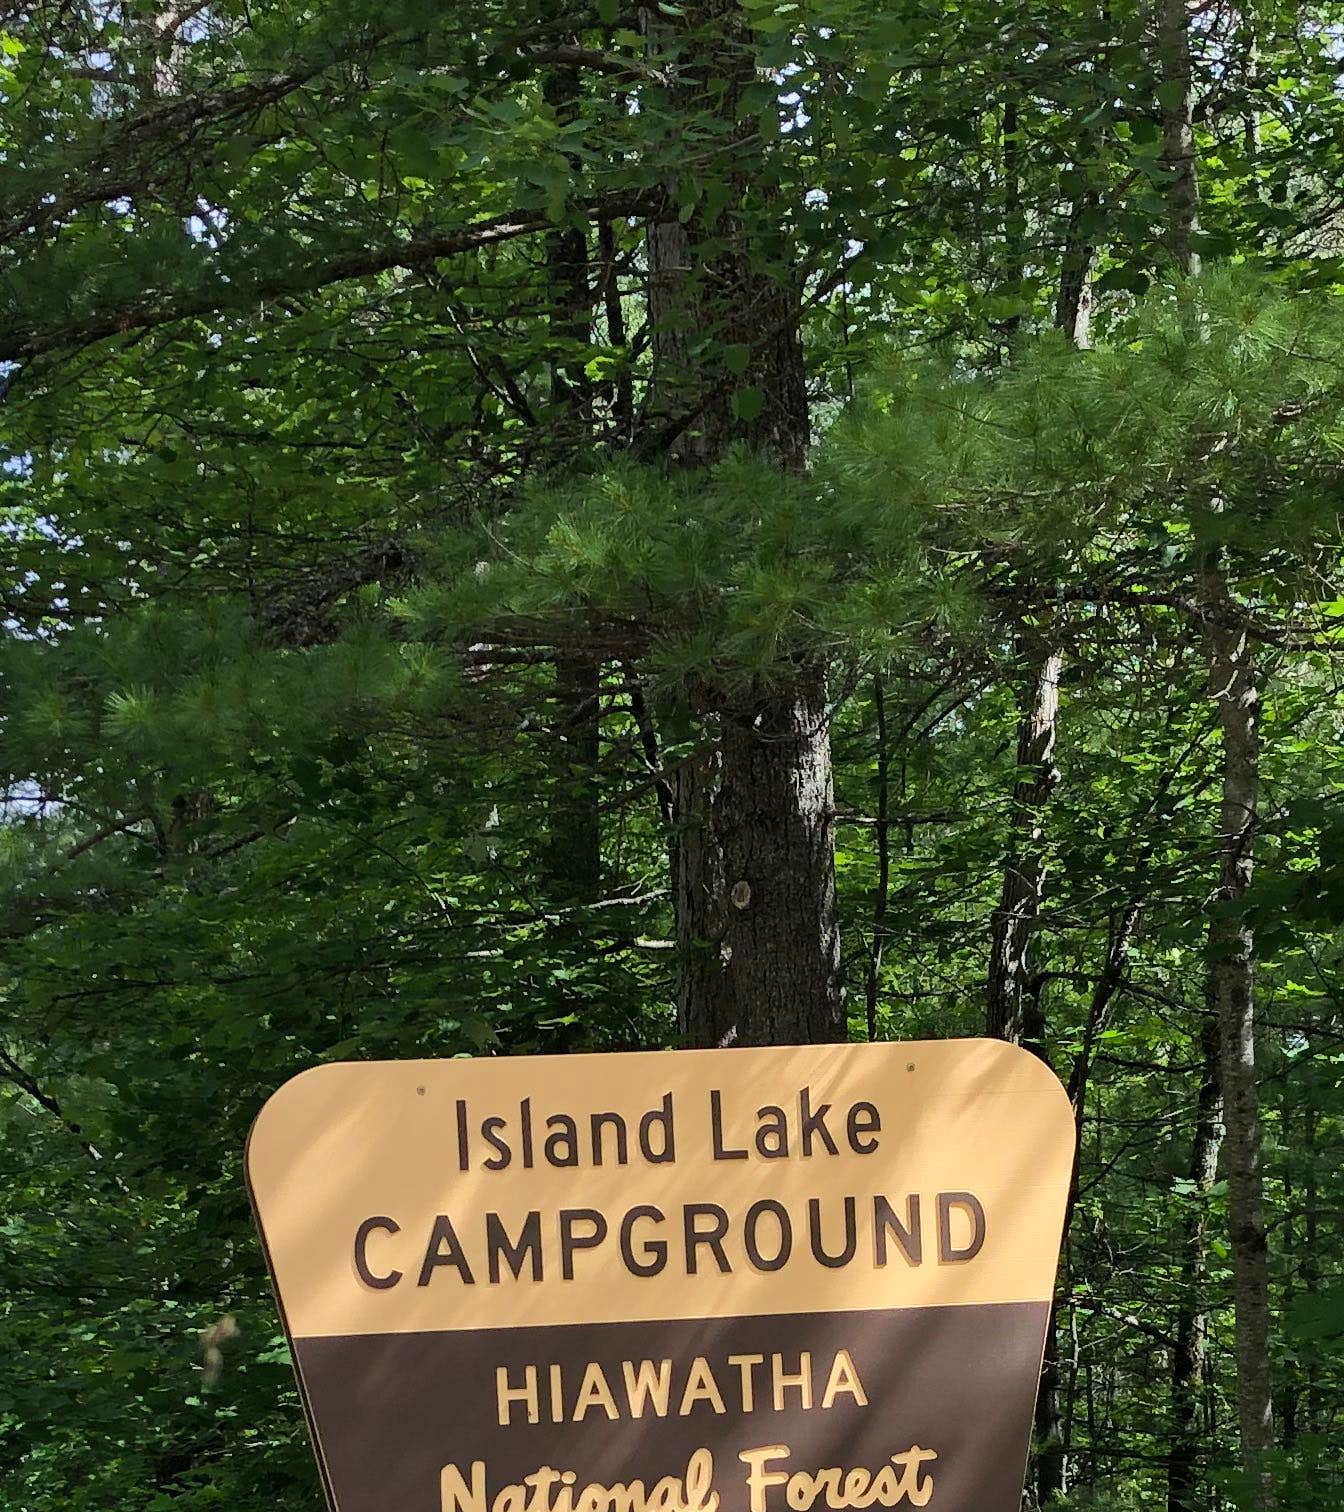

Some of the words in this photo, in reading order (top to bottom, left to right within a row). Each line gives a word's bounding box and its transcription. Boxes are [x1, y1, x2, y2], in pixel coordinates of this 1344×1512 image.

[456, 1091, 675, 1172] Island
[710, 1086, 882, 1163] Lake
[352, 1190, 988, 1290] CAMPGROUND
[496, 1348, 870, 1427] HIAWATHA
